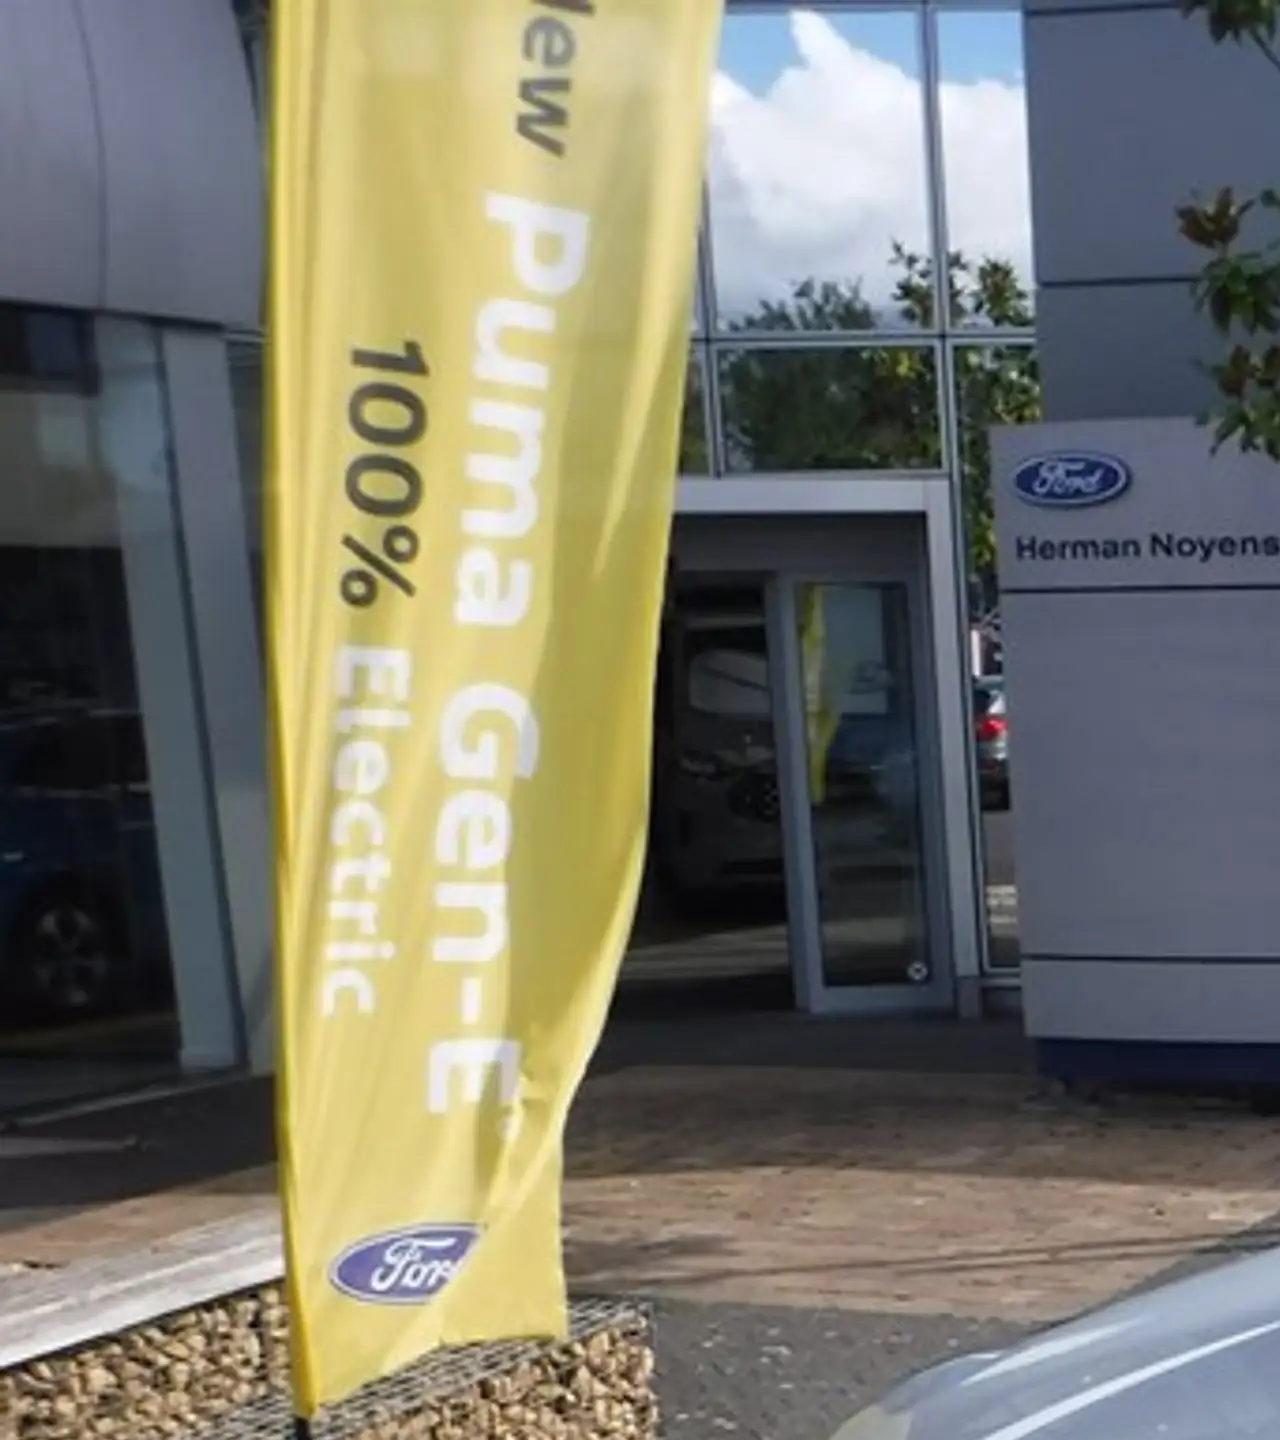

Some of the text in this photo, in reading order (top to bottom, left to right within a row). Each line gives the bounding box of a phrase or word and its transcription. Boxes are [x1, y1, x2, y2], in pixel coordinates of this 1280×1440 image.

[320, 340, 431, 1018] 100% Electric
[425, 0, 596, 1115] ew Puma Gen-E
[1015, 533, 1141, 561] Herman
